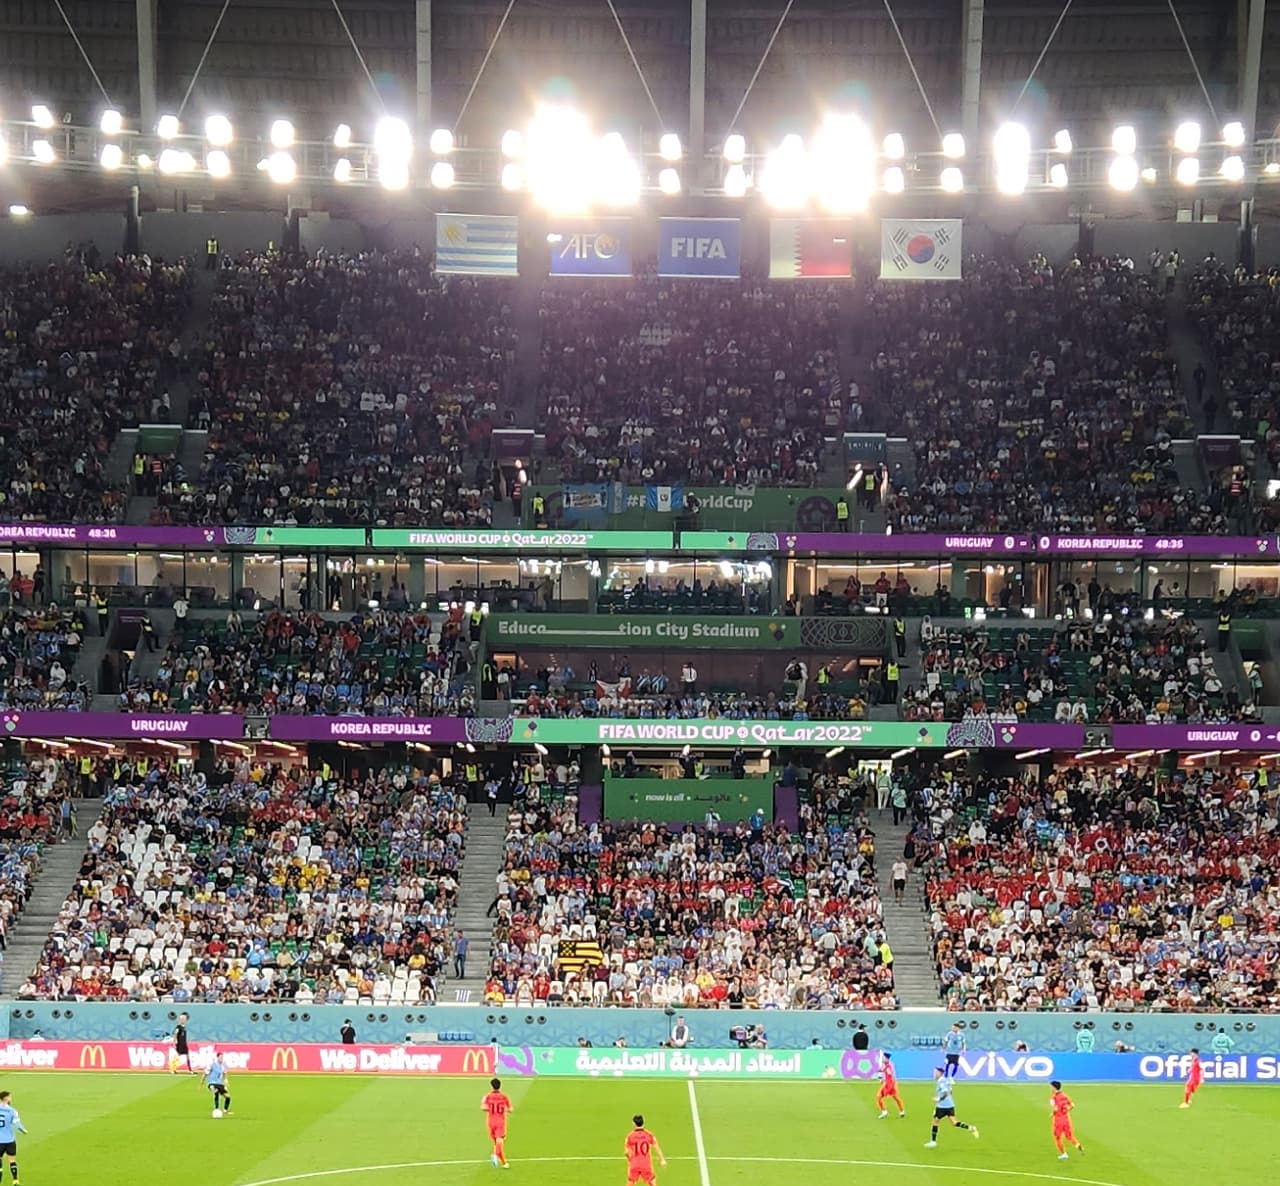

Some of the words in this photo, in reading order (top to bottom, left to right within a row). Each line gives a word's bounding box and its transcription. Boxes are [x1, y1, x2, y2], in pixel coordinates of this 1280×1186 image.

[671, 238, 726, 259] FIFA
[25, 527, 76, 538] REPUBLIC
[409, 533, 435, 545] FIFA
[435, 533, 476, 545] WORLD
[478, 533, 501, 545] CUP
[945, 537, 994, 548] URUGUAY
[1004, 536, 1015, 549] 0
[1040, 537, 1051, 549] 0
[1057, 538, 1091, 549] KOREA
[1092, 538, 1144, 549] REPUBLIC
[655, 622, 688, 640] City
[692, 623, 760, 638] Stadium
[131, 719, 188, 732] URUGUAY
[330, 722, 370, 735] KOREA
[372, 722, 432, 735] REPUBLIC
[599, 724, 636, 739] FIFA
[637, 724, 698, 740] WORLD
[700, 724, 735, 740] CUP
[1187, 730, 1239, 742] URUGUAY
[1250, 730, 1261, 742] 0
[128, 1047, 164, 1067] We
[321, 1048, 357, 1069] We
[360, 1048, 441, 1071] Deliver
[576, 1051, 666, 1076] التعليمية
[671, 1051, 741, 1077] المدينة
[746, 1053, 800, 1073] استاد
[960, 1054, 1052, 1077] vivo
[489, 1103, 504, 1115] 16
[633, 1141, 649, 1156] 10
